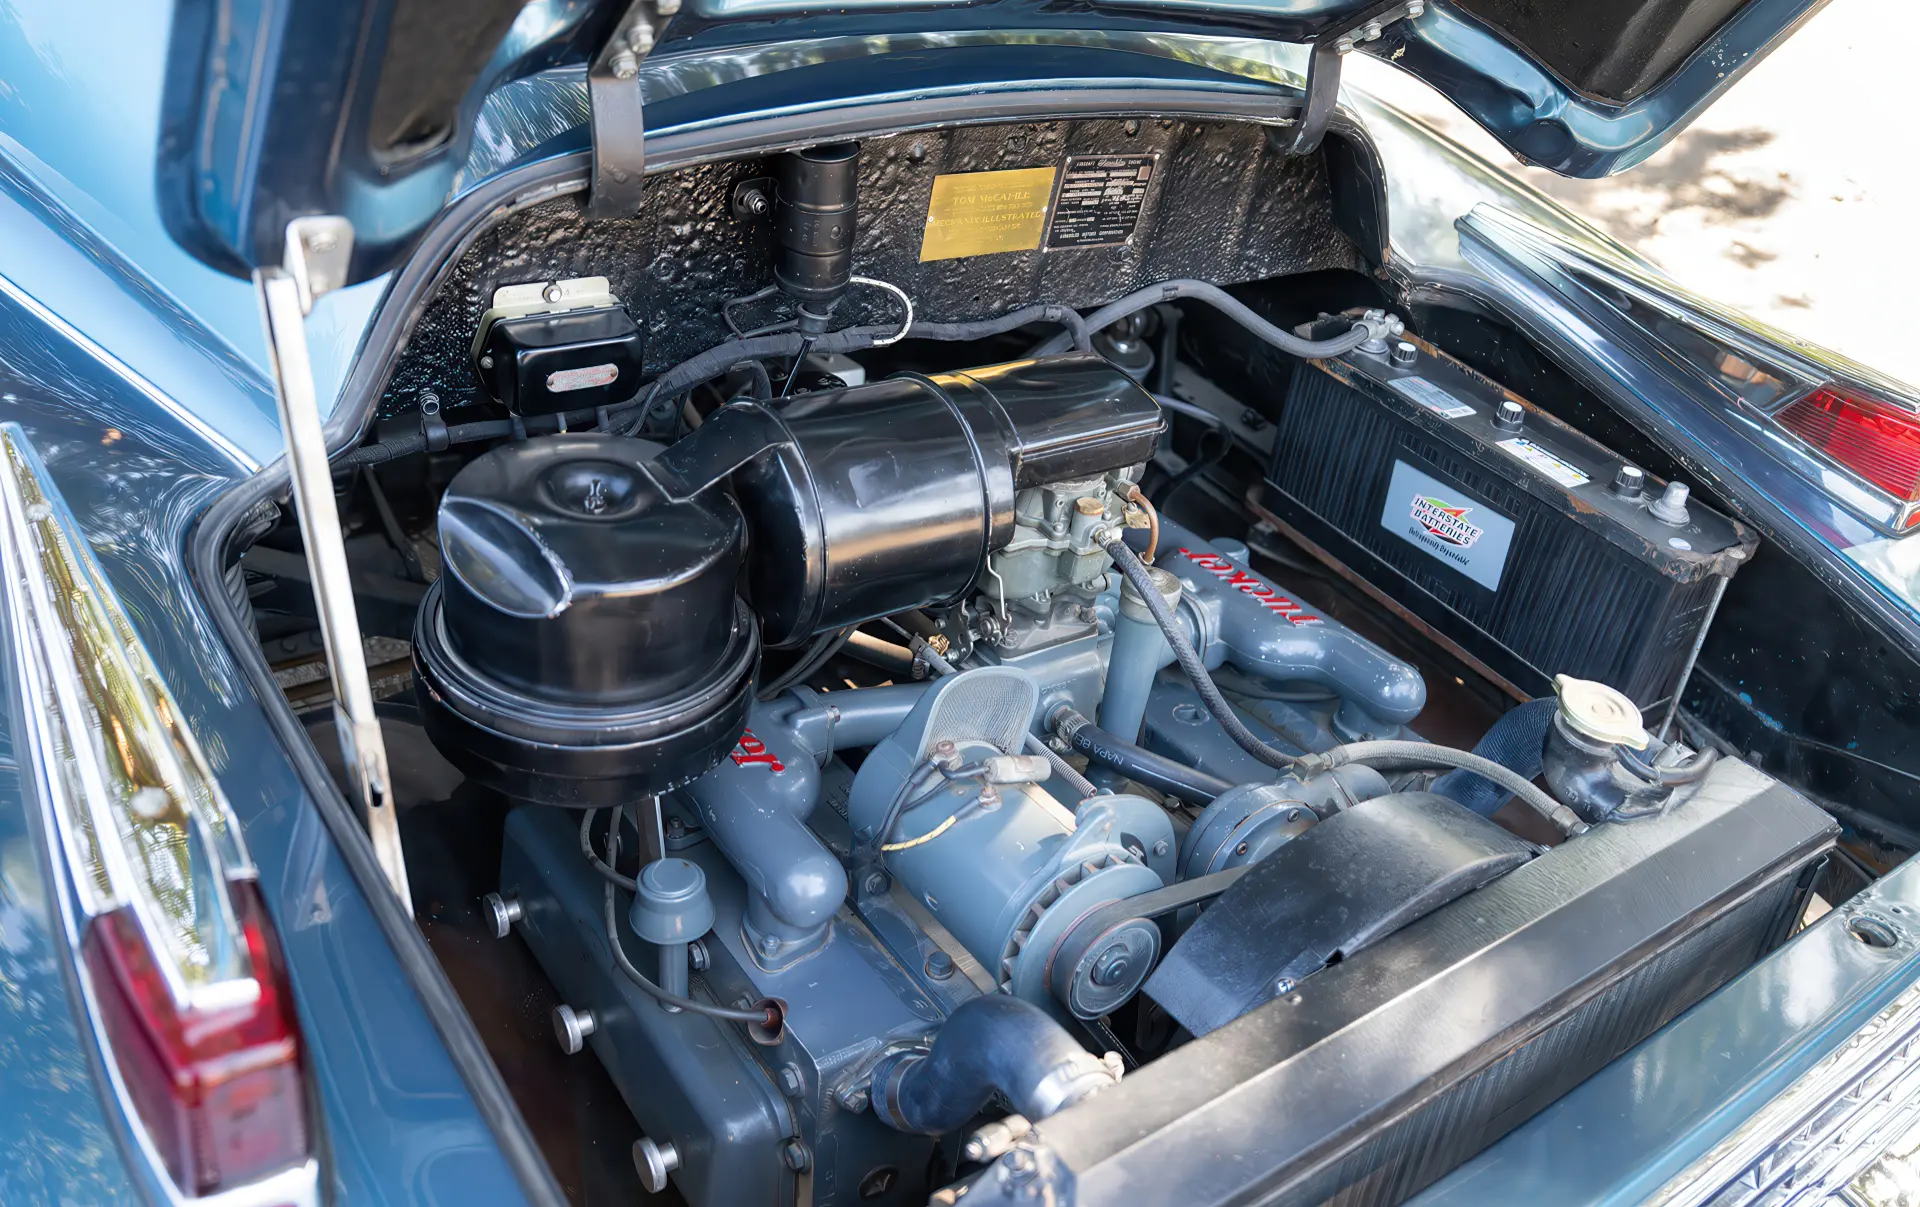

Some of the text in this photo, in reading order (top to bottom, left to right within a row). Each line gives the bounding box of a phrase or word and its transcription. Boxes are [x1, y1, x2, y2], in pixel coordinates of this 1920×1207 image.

[953, 196, 976, 206] TOM
[1414, 497, 1478, 537] INTERSTATE
[1414, 509, 1471, 545] BATTERIES
[1093, 743, 1124, 765] NAPA
